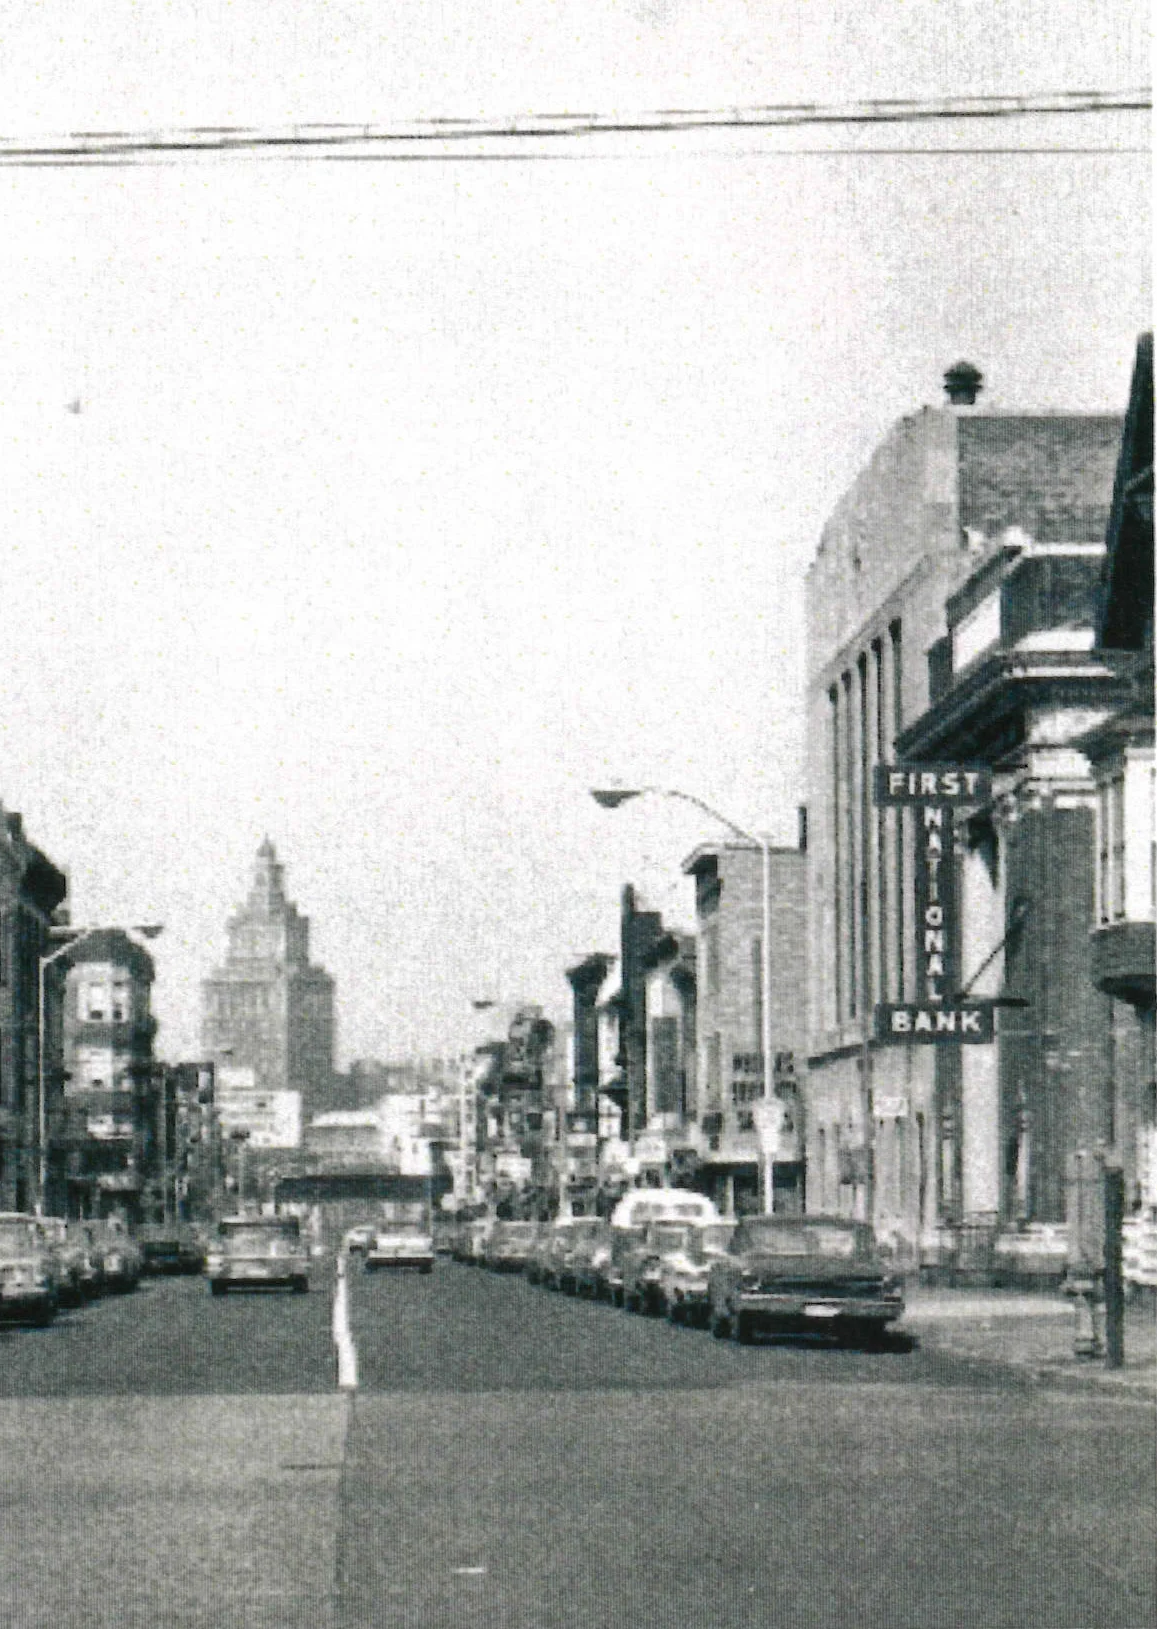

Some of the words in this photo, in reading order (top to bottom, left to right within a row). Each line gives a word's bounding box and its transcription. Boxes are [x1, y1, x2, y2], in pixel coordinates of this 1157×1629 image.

[889, 772, 979, 796] FIRST
[924, 806, 943, 1001] NATIONAL
[891, 1010, 981, 1032] BANK
